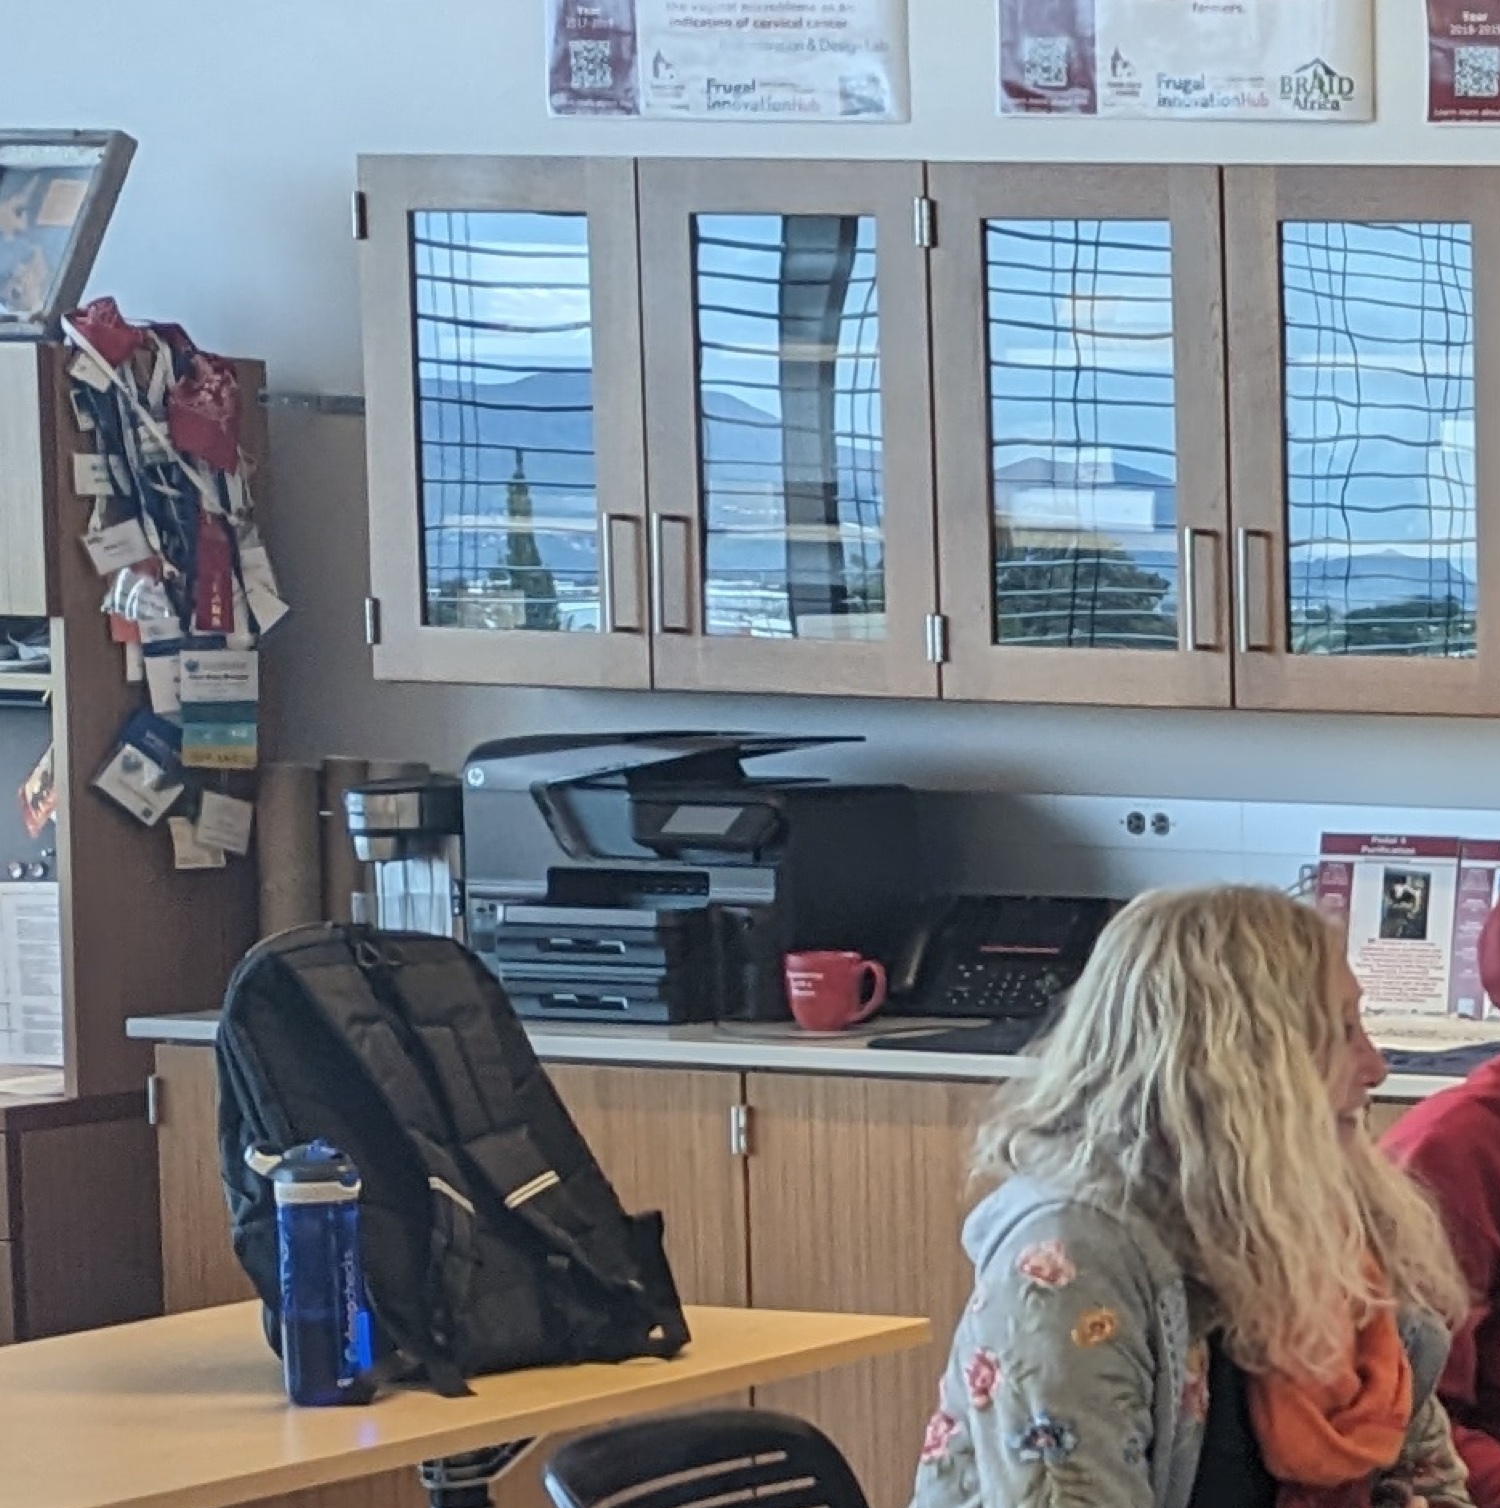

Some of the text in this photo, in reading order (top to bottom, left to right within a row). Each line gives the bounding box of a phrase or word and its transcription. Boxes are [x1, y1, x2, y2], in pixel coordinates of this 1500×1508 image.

[706, 78, 756, 95] Frugal
[1156, 73, 1206, 92] Frugal
[1279, 75, 1355, 97] BRAID
[1291, 97, 1342, 112] Africa
